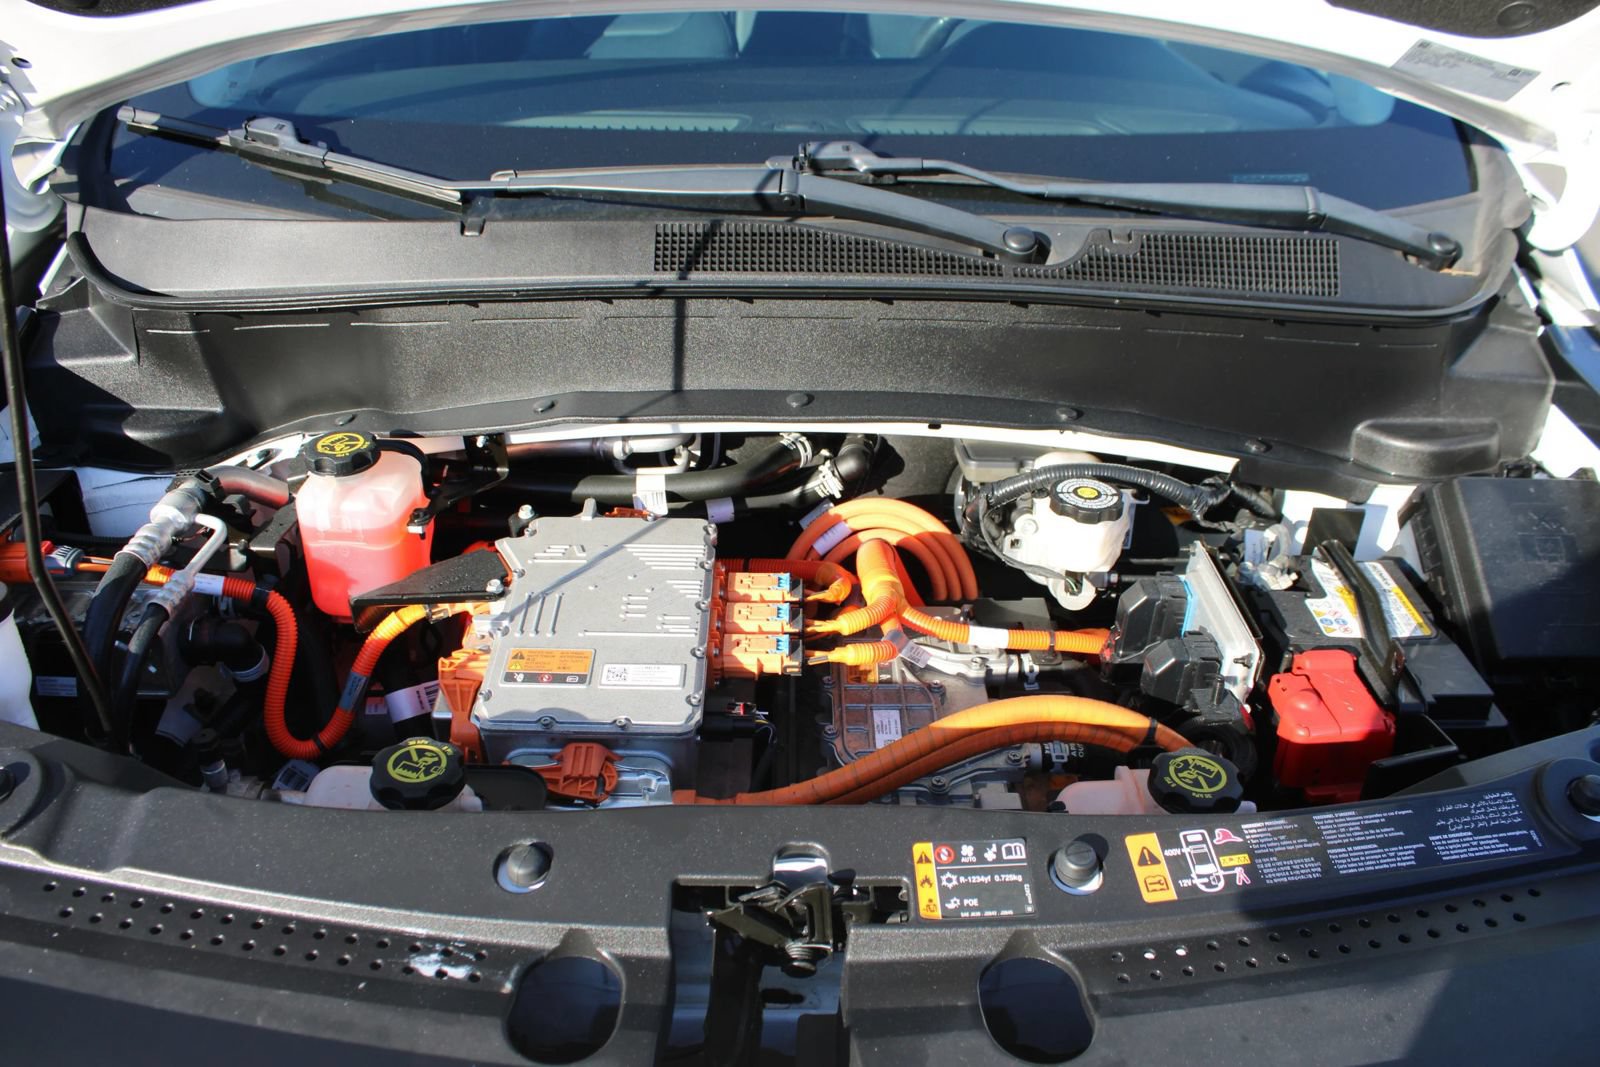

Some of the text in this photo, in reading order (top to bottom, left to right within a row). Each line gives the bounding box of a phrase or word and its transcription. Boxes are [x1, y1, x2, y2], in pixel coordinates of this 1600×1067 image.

[1164, 848, 1181, 856] 400V
[960, 875, 991, 884] R-1234yf
[1178, 878, 1192, 887] 12V
[964, 898, 978, 906] POE
